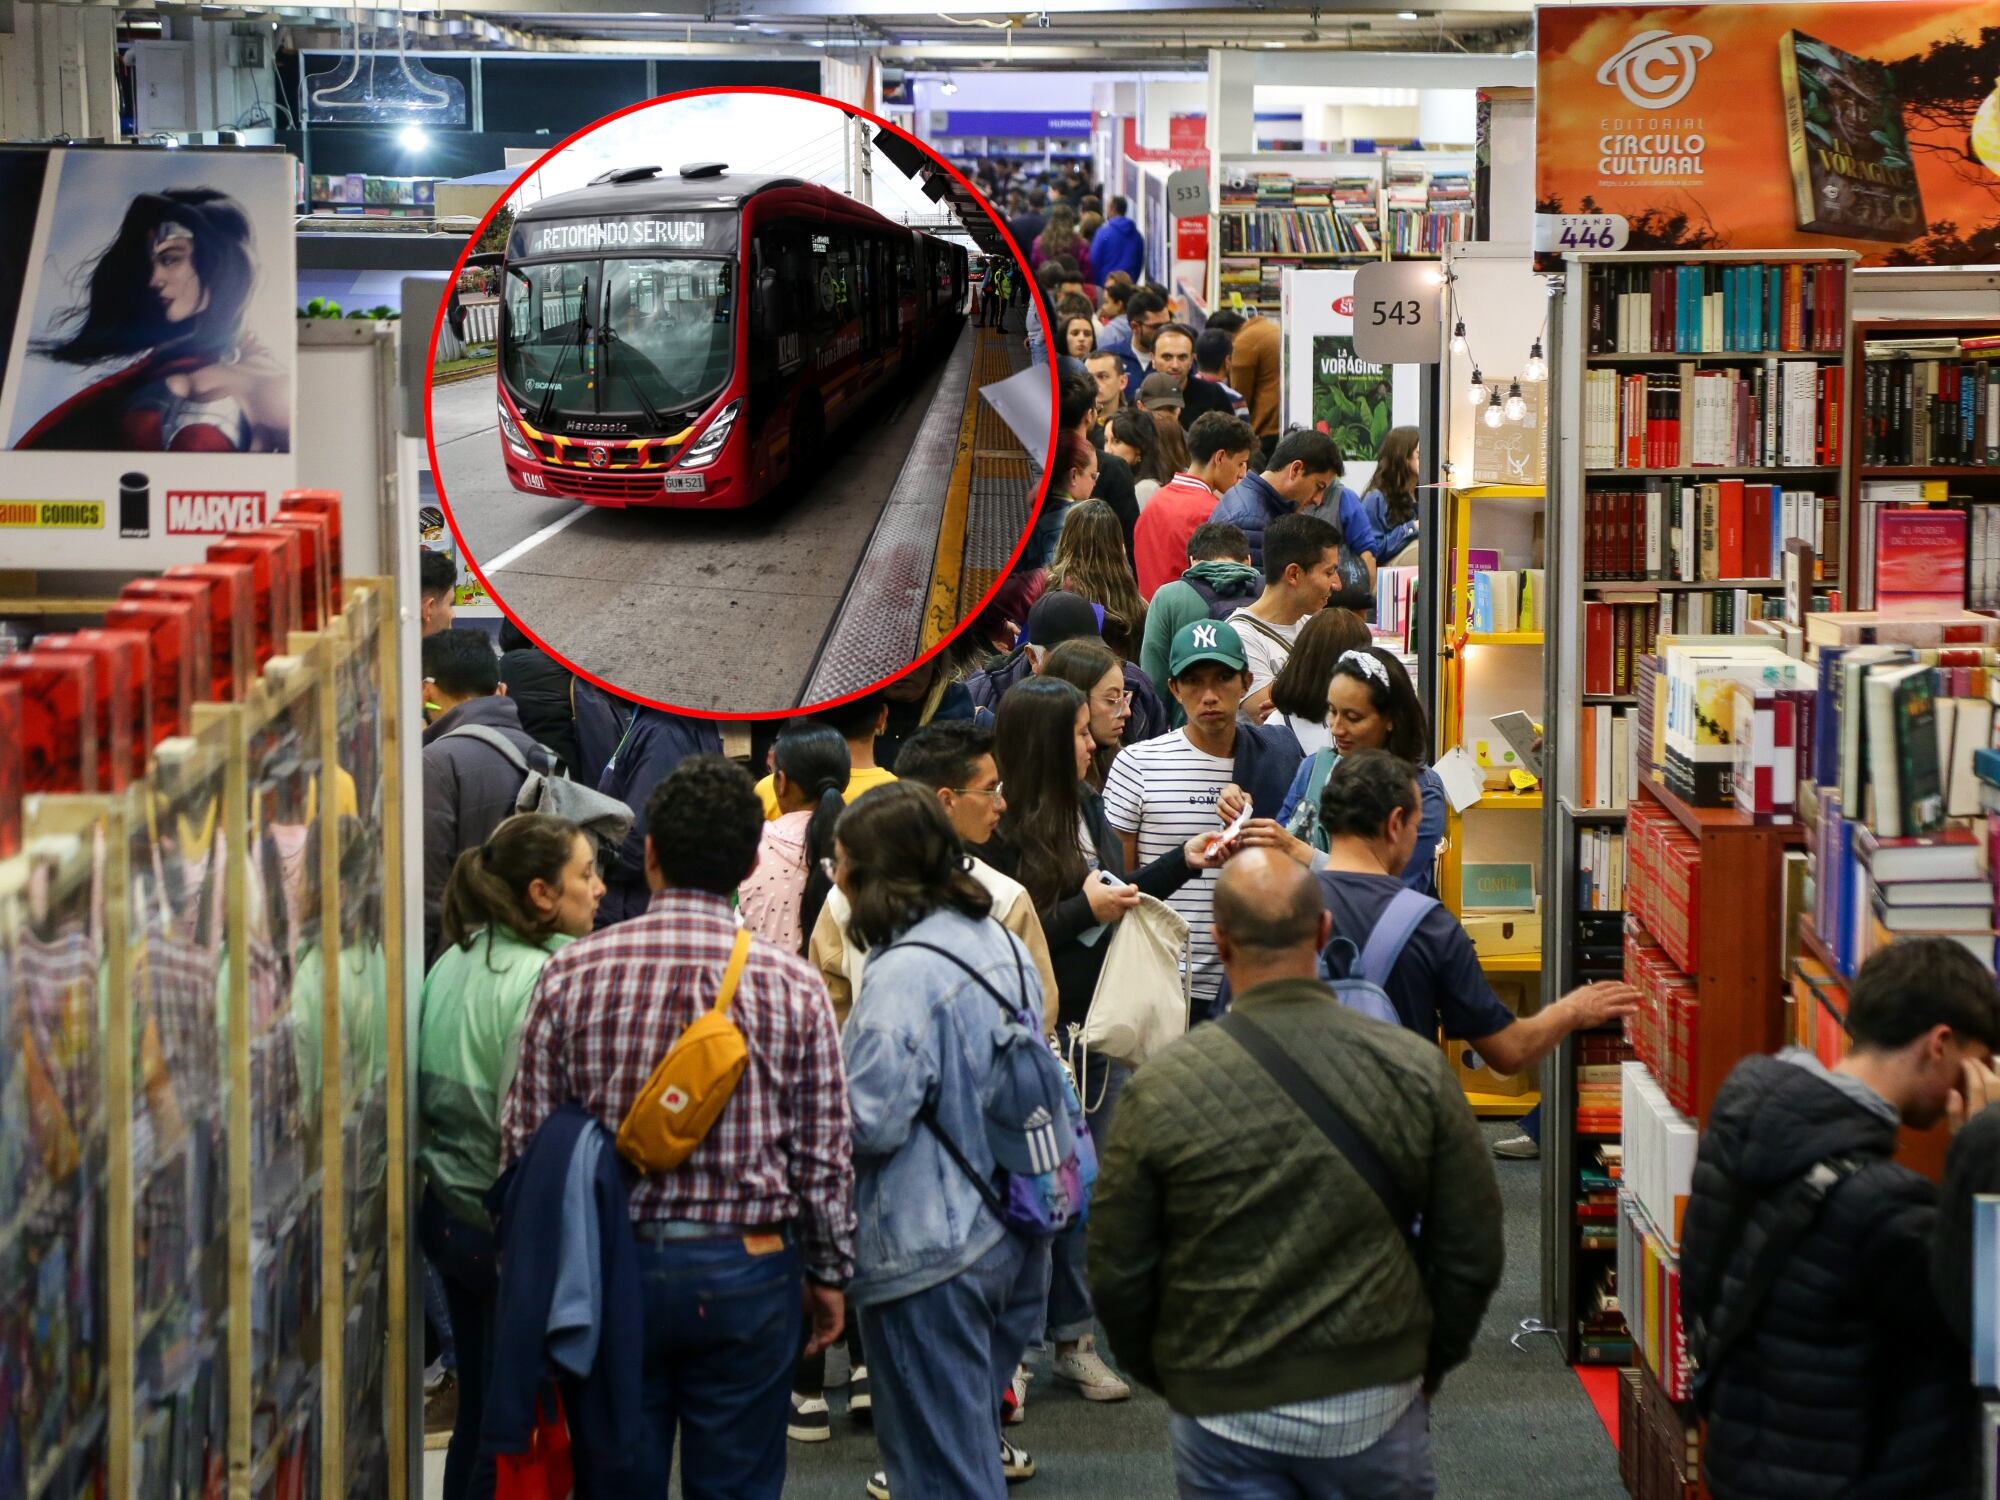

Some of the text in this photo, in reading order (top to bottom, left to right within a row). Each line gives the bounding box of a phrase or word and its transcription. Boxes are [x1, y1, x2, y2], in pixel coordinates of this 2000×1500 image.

[1601, 118, 1704, 130] EDITORIAL
[1599, 134, 1705, 155] CÍRCULO
[1599, 156, 1704, 175] CULTURAL
[1176, 186, 1201, 201] 533
[1562, 218, 1613, 226] STAND
[543, 222, 629, 250] RETOMANDO
[1559, 226, 1615, 249] 446
[1372, 300, 1421, 326] 543
[1337, 348, 1347, 358] LA
[1321, 355, 1384, 375] VORÁGINE
[534, 382, 562, 391] SCANIA
[566, 420, 628, 432] Marcopolo
[522, 471, 546, 488] K1401
[666, 476, 703, 489] GUW 521
[168, 494, 263, 531] MARVEL
[1192, 624, 1218, 649] NY
[1208, 786, 1222, 795] ST
